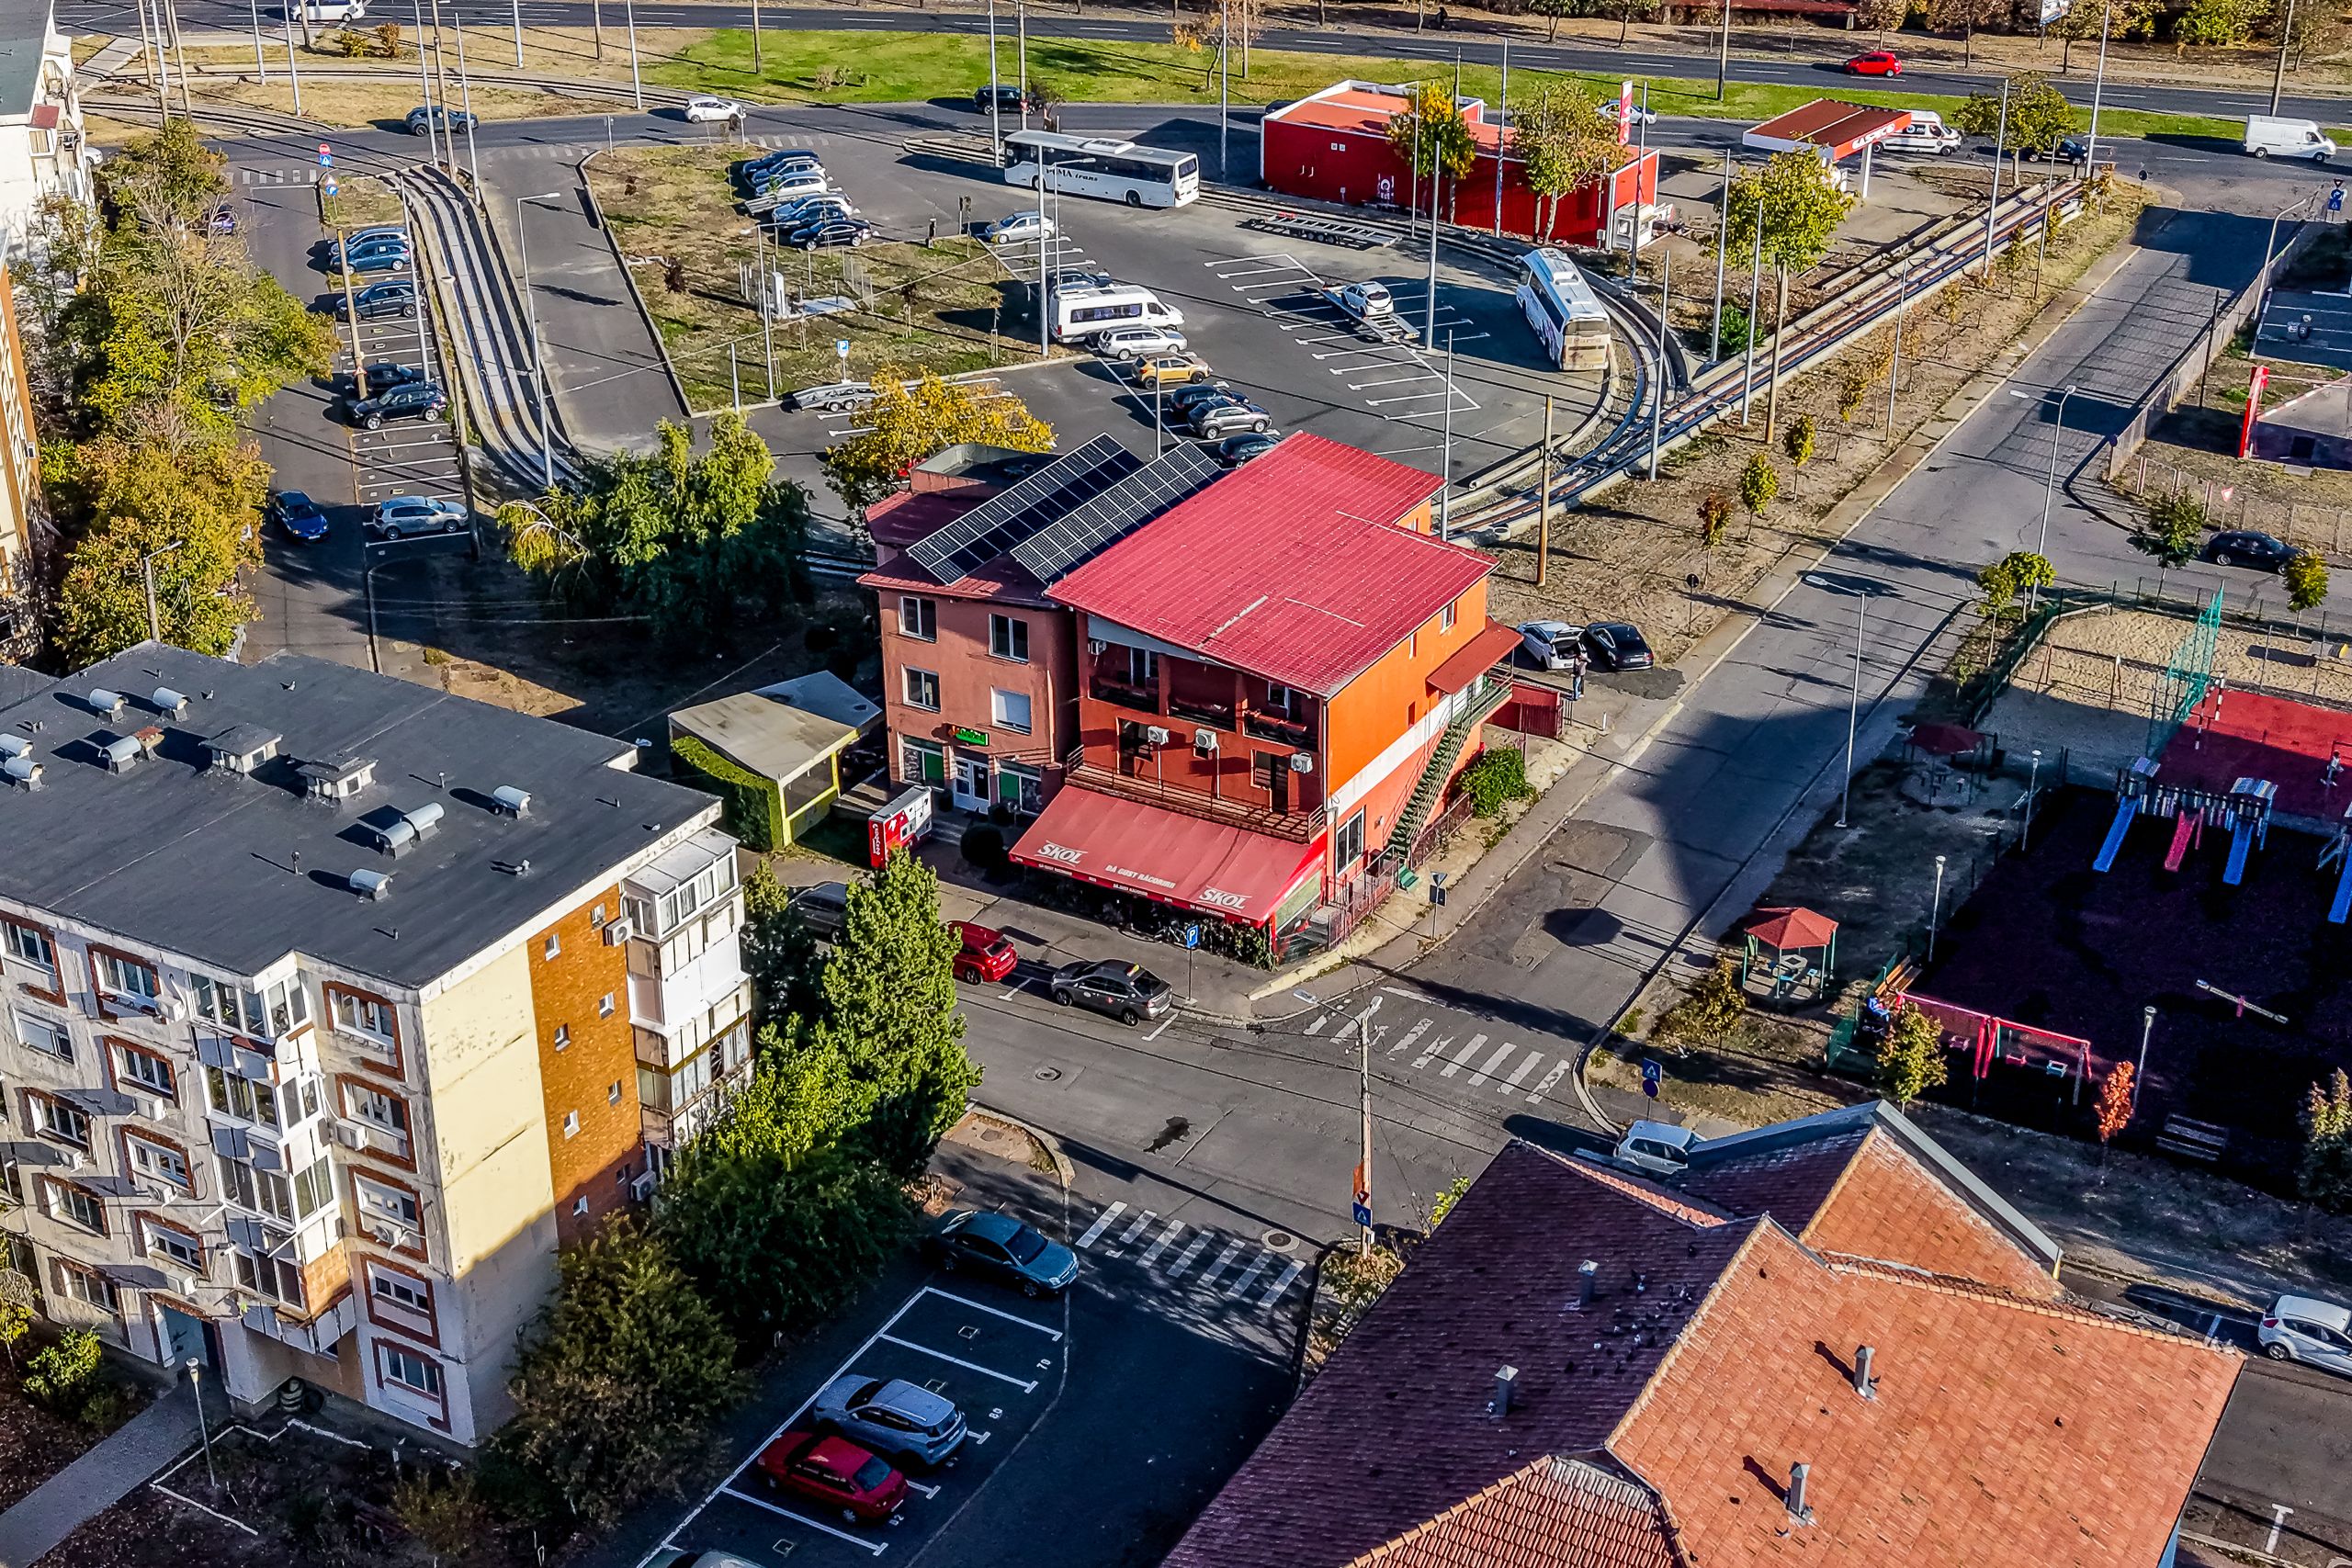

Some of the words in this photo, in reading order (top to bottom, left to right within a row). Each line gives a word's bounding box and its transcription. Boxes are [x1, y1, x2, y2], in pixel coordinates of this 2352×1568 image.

[1075, 173, 1098, 182] trans
[1037, 843, 1084, 864] SKOL
[1117, 867, 1138, 879] GUST
[1199, 888, 1248, 909] SKOL
[1189, 929, 1196, 942] P
